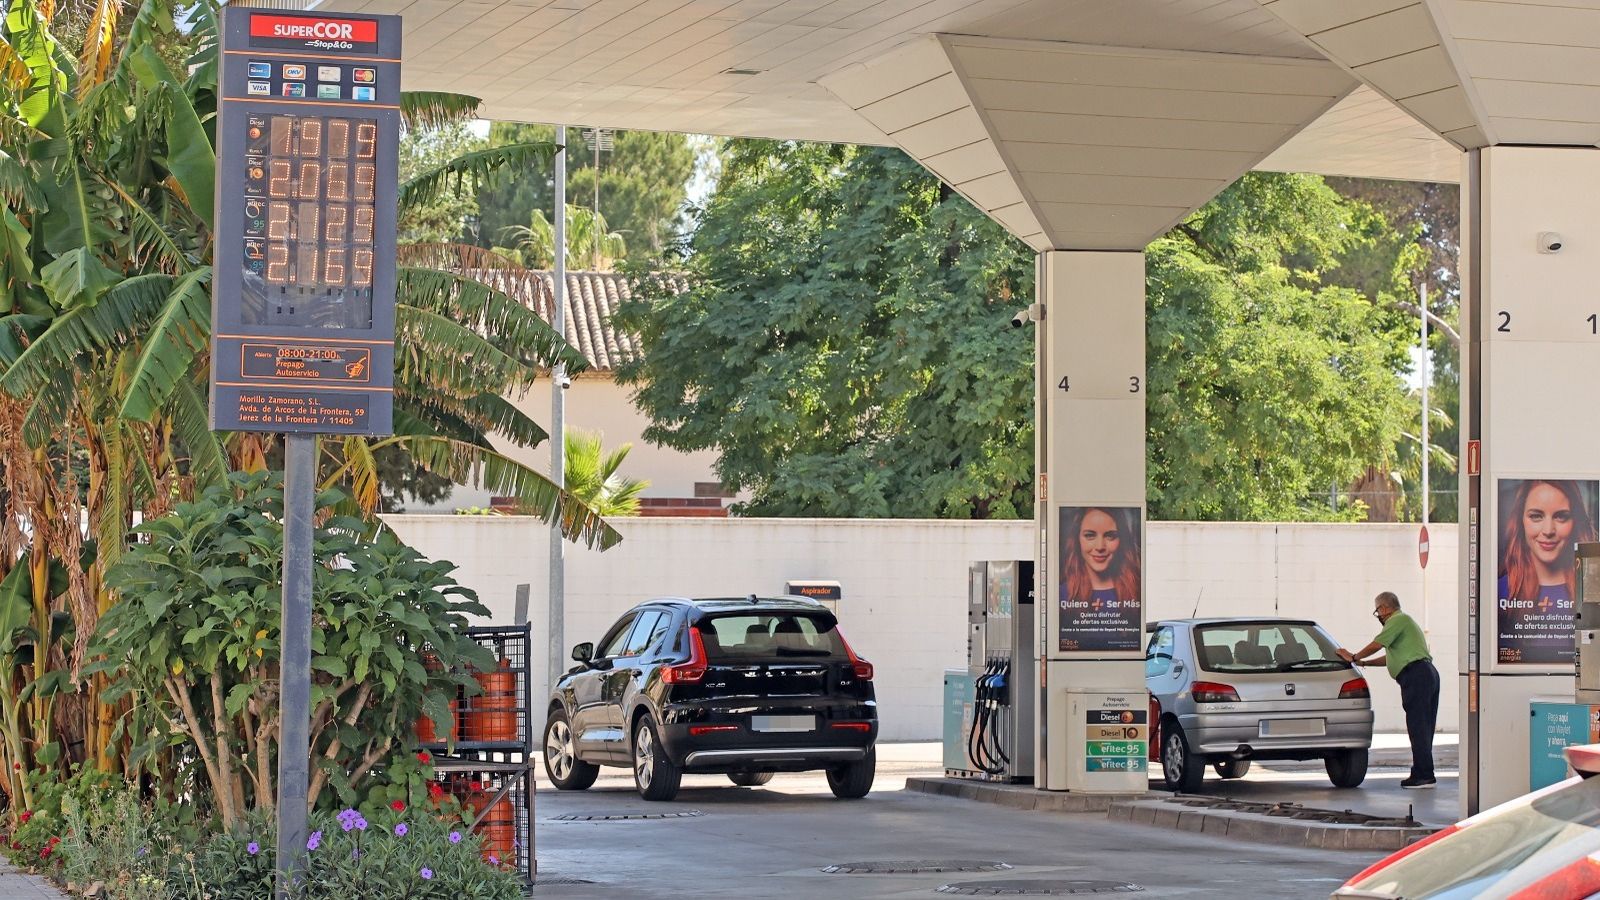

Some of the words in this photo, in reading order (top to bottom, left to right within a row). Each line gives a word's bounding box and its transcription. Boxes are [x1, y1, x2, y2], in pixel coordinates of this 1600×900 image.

[313, 40, 353, 50] Stop&Go
[253, 220, 265, 228] 95
[252, 260, 264, 269] 95
[1498, 311, 1511, 332] 2
[1586, 314, 1597, 334] 1
[275, 360, 305, 369] Prepago
[275, 369, 320, 378] Autoservicio
[1058, 376, 1070, 392] 4
[1129, 376, 1140, 393] 3
[239, 395, 266, 404] Morillo
[268, 396, 305, 406] Zamorano,
[308, 398, 321, 406] S.L.
[239, 404, 259, 413] Avda.
[262, 405, 271, 413] de
[274, 406, 295, 414] Arcos
[298, 406, 307, 414] de
[309, 407, 317, 415] la
[354, 408, 365, 417] 59
[239, 413, 259, 422] Jerez
[262, 414, 272, 422] de
[275, 415, 283, 423] la
[285, 415, 318, 424] Frontera
[329, 417, 354, 425] 11405
[801, 587, 832, 596] Aspirador
[1060, 600, 1089, 609] Quiero
[1106, 600, 1122, 608] Ser
[1500, 598, 1533, 610] Quiero
[1556, 599, 1574, 609] Ser
[1523, 613, 1545, 621] Quiero
[1546, 613, 1574, 621] disfrutar
[1524, 622, 1548, 630] ofertas
[1549, 622, 1576, 630] exclusiv
[1100, 713, 1121, 721] Diesel
[1122, 727, 1139, 739] 10
[1101, 744, 1126, 753] efitec
[1126, 744, 1140, 754] 95
[1101, 760, 1126, 769] efitec
[1126, 760, 1140, 769] 95
